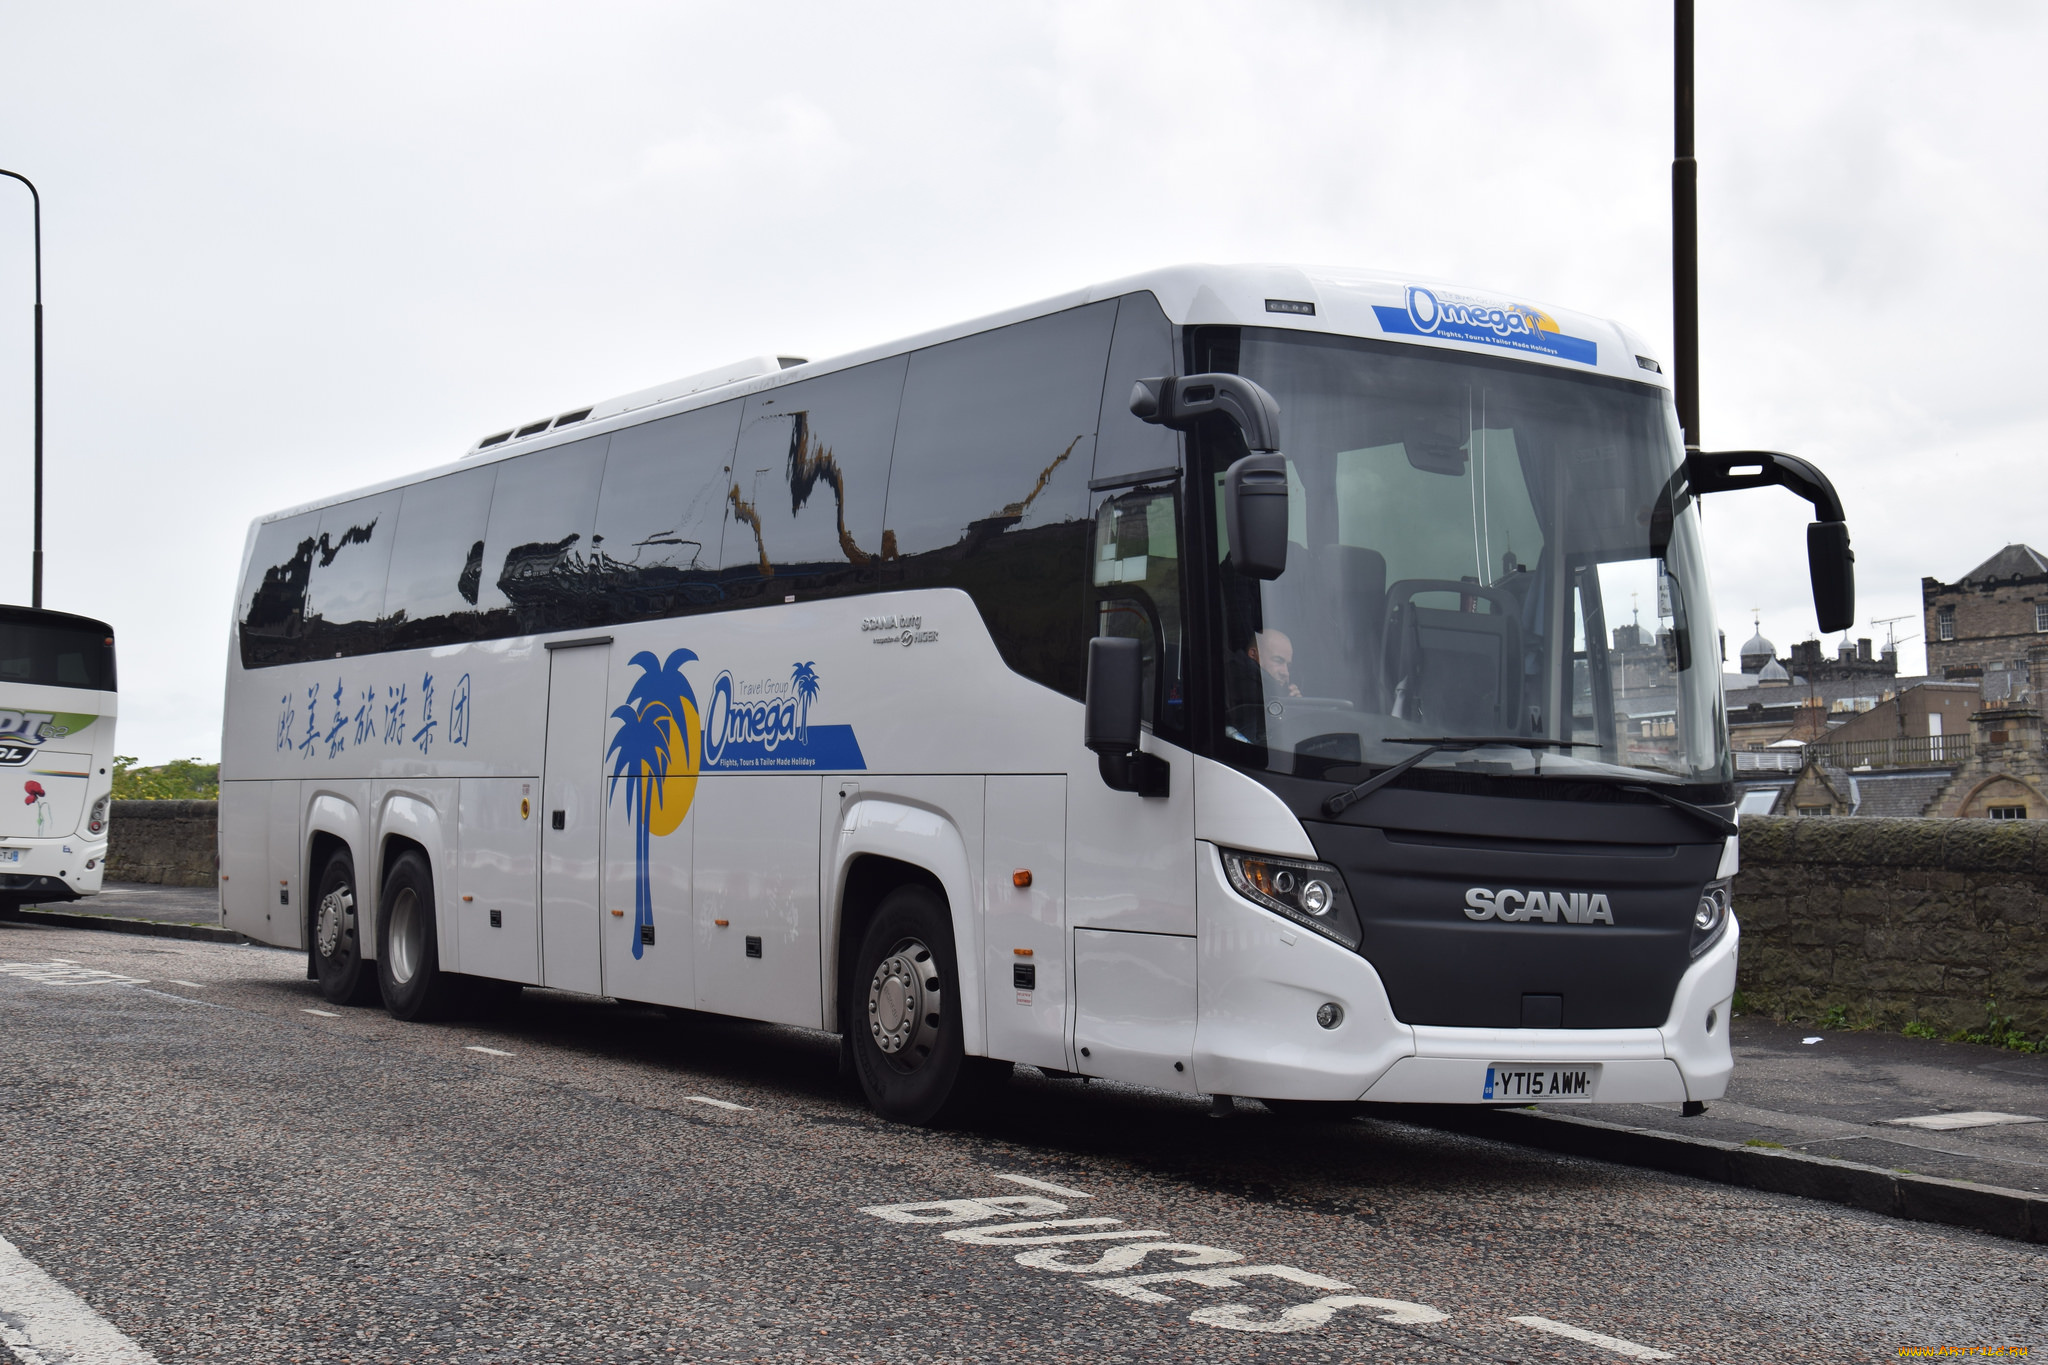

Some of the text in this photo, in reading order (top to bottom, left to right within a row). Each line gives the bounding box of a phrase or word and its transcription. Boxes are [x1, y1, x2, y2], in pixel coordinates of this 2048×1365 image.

[1404, 284, 1530, 337] Omega
[1437, 330, 1464, 339] Flights,
[1465, 333, 1485, 342] Tours
[1492, 337, 1511, 346] Tailor
[1512, 340, 1530, 349] Made
[1530, 344, 1558, 355] Holidays
[739, 678, 789, 699] Travel Group
[705, 670, 798, 765] Omega
[720, 758, 739, 767] Flights,
[739, 758, 755, 766] Tours
[760, 758, 776, 766] Tailor
[776, 758, 791, 766] Made
[791, 757, 816, 767] Holidays
[1464, 887, 1614, 925] SCANIA
[1500, 1071, 1586, 1095] YT15 AWM
[858, 1195, 1451, 1334] BUSES
